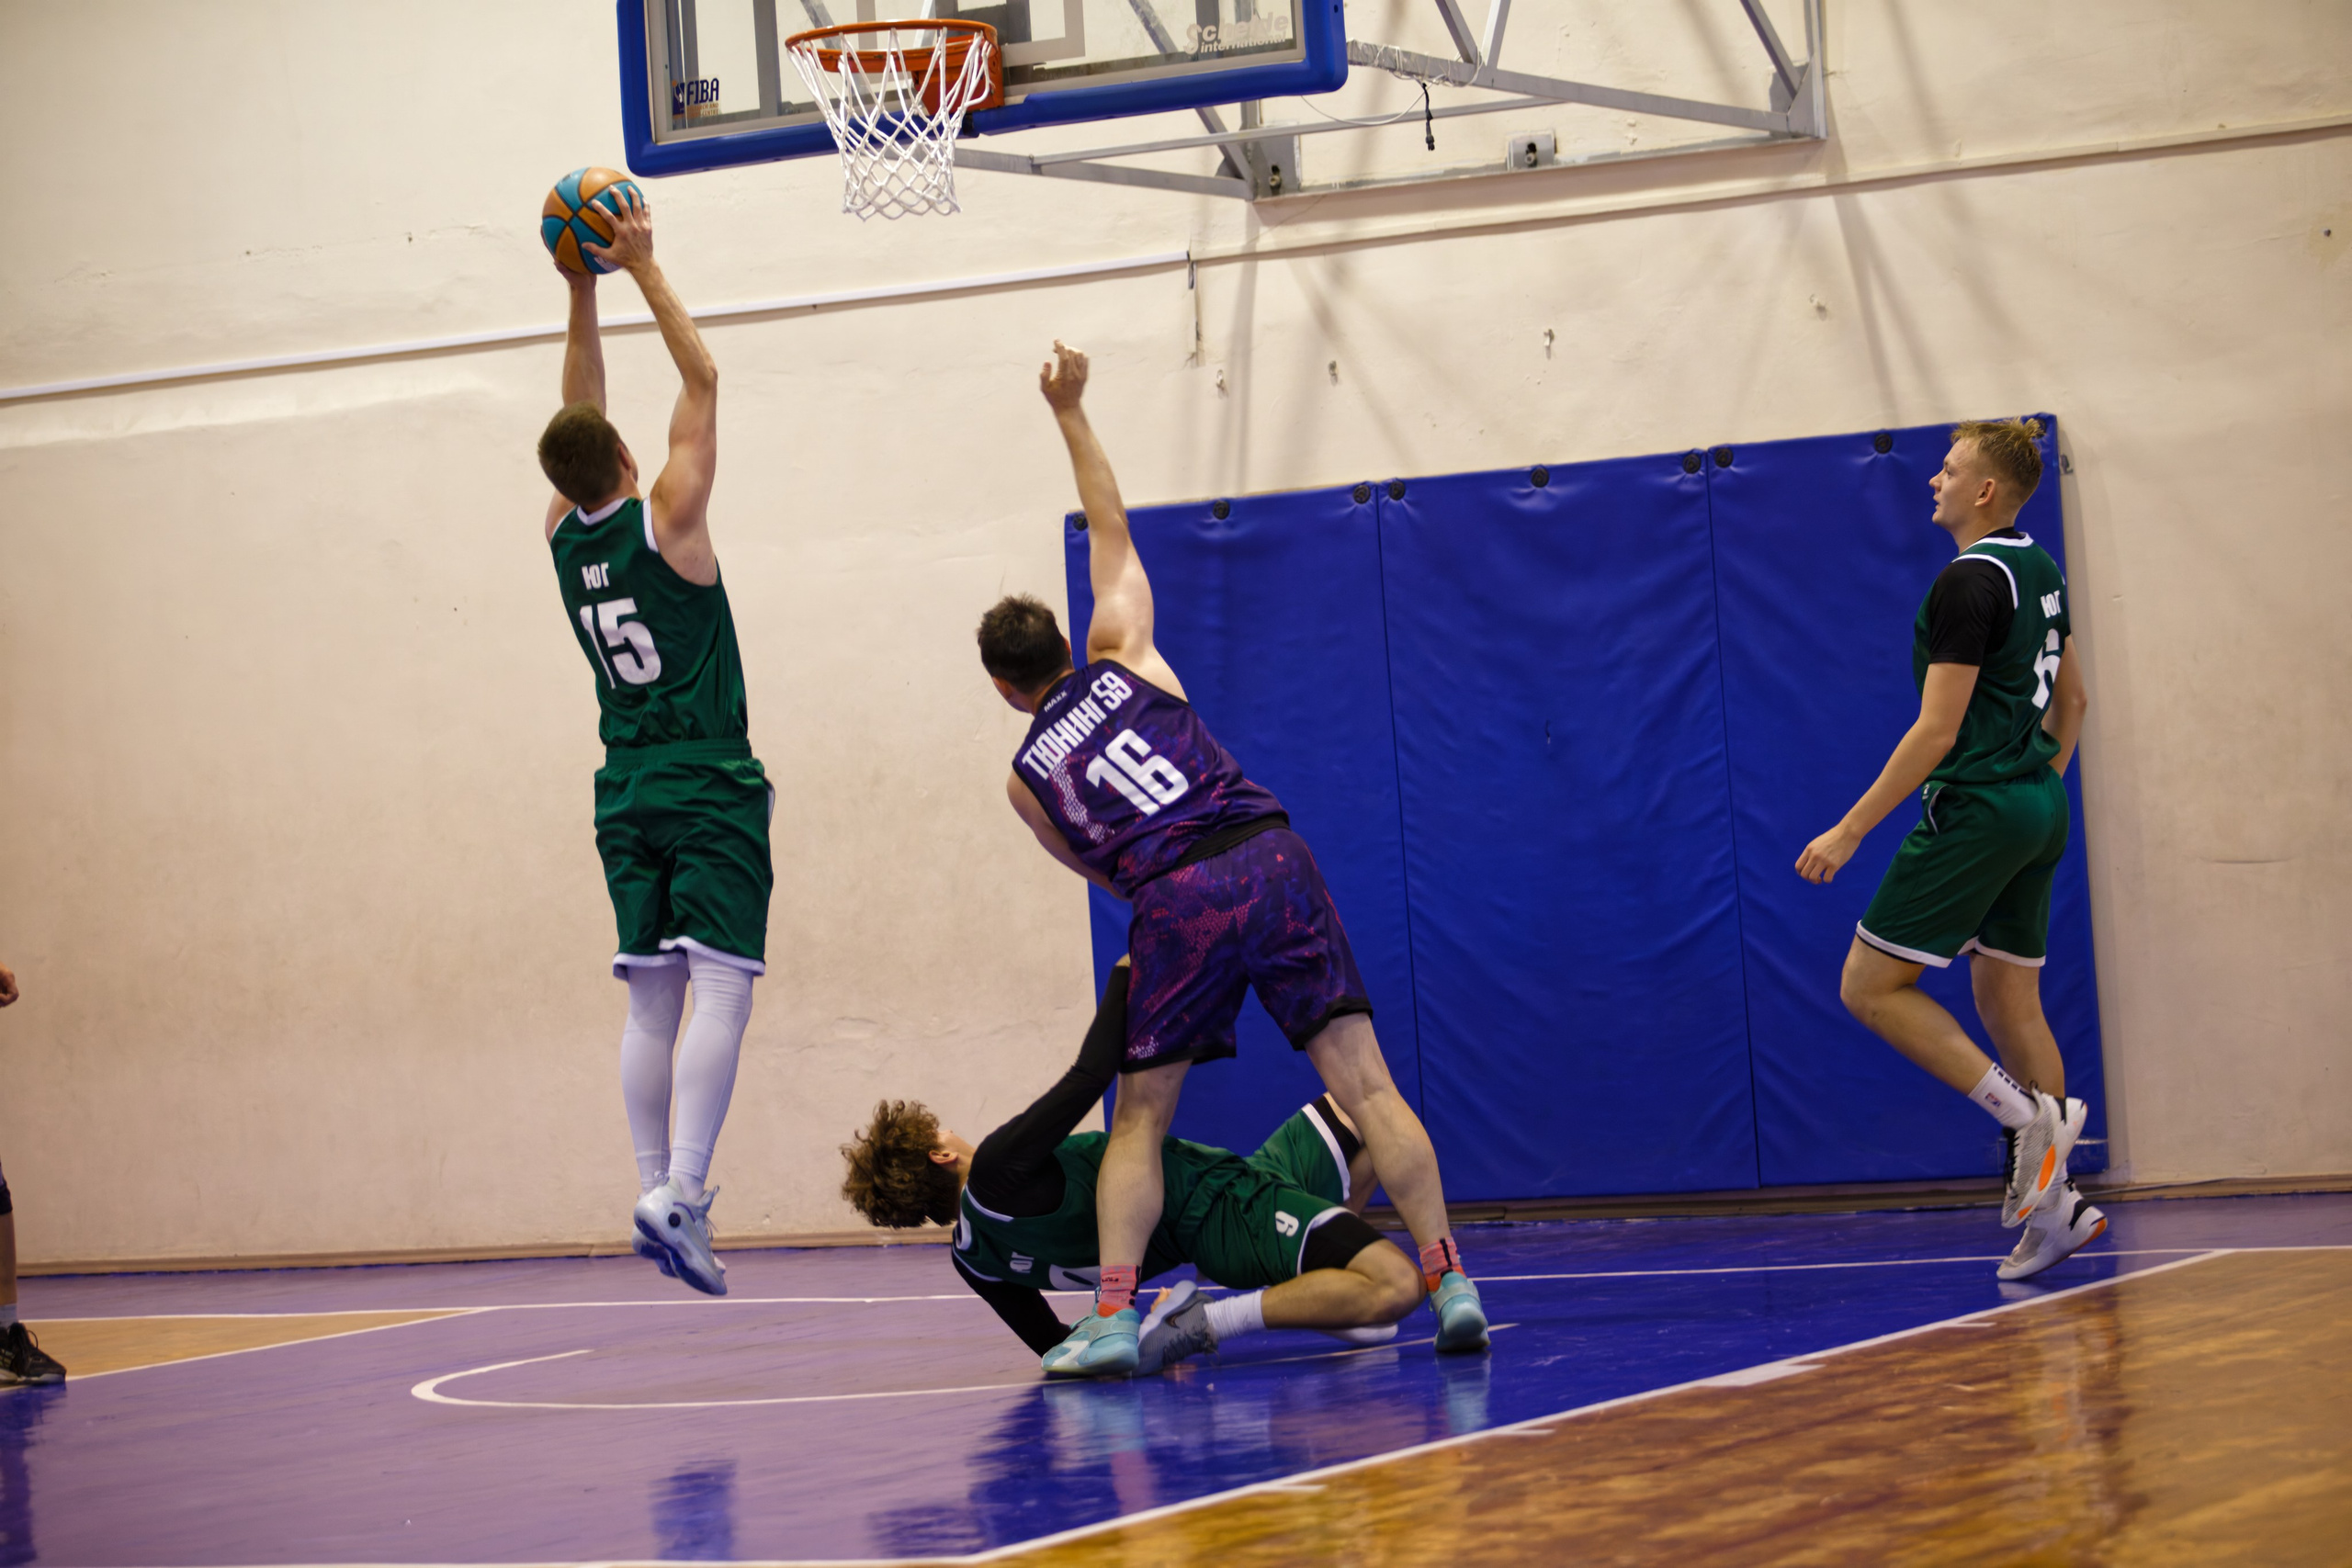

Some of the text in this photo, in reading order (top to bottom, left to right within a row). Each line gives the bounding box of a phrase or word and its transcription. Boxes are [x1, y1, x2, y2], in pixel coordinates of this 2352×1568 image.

[686, 78, 719, 106] FIBA
[582, 562, 609, 591] ЮГ
[2041, 590, 2061, 619] ЮГ
[580, 597, 662, 689] 15
[1086, 728, 1189, 817] 16
